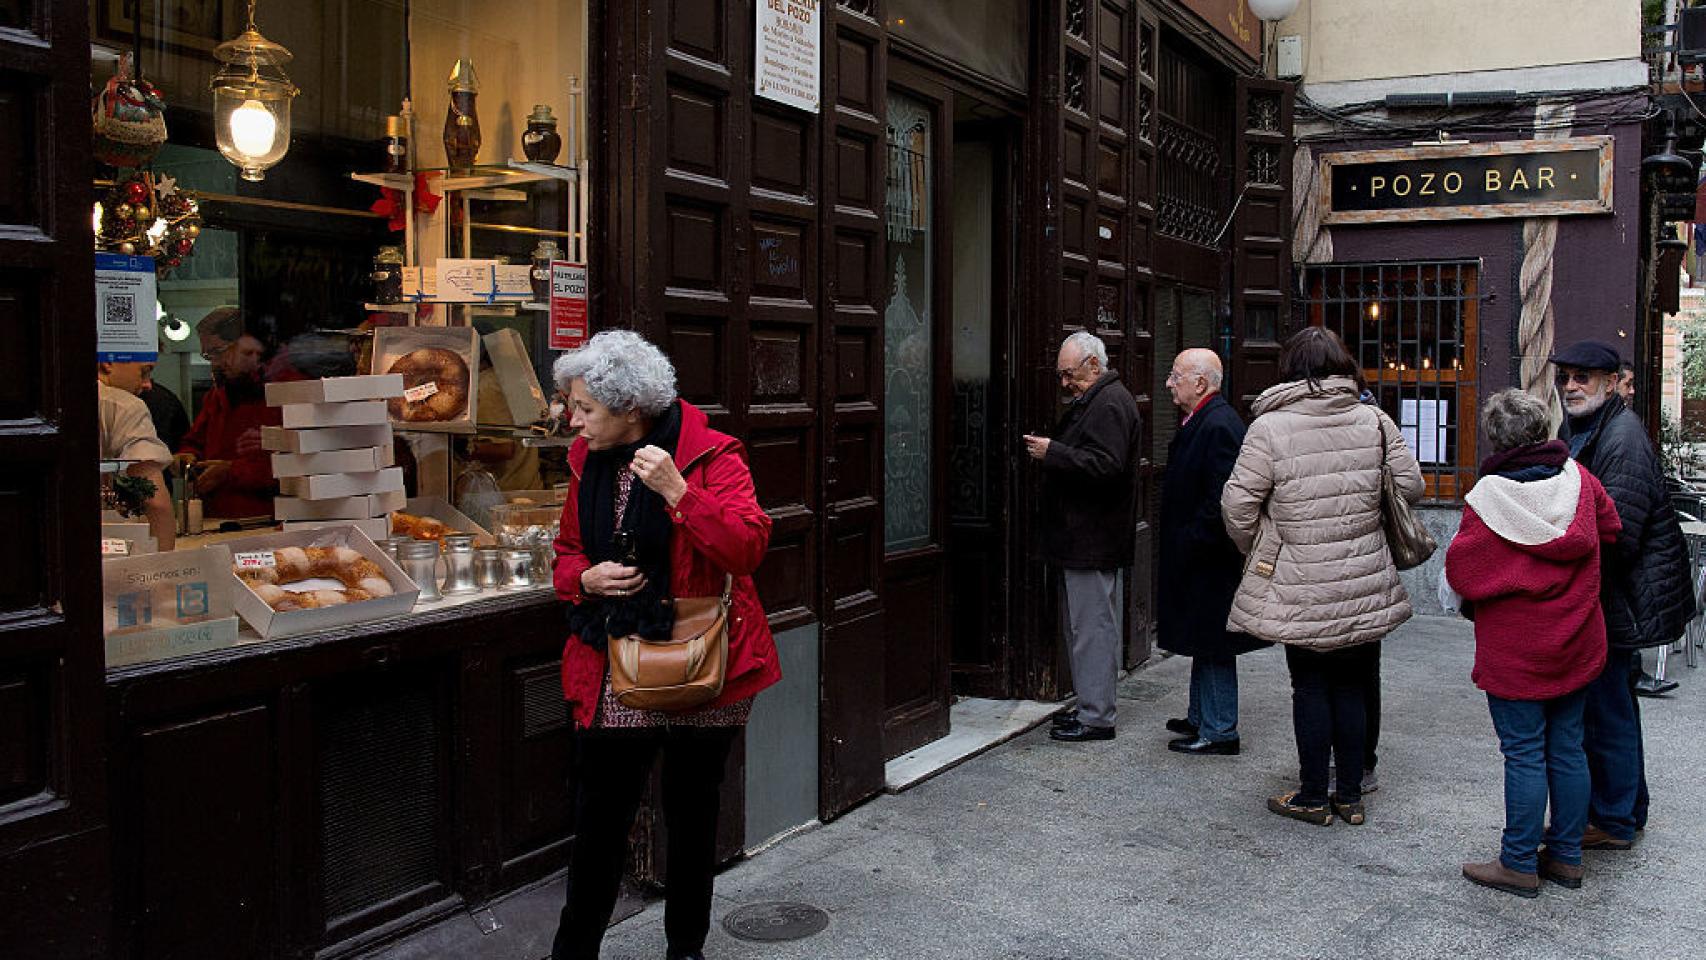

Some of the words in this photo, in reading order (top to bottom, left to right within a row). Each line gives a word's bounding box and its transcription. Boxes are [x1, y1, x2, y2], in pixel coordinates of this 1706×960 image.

[768, 0, 785, 14] DEL
[788, 5, 811, 24] POZO
[1371, 172, 1462, 198] POZO
[1485, 167, 1555, 192] BAR
[553, 283, 564, 293] EL
[564, 284, 585, 294] POZO
